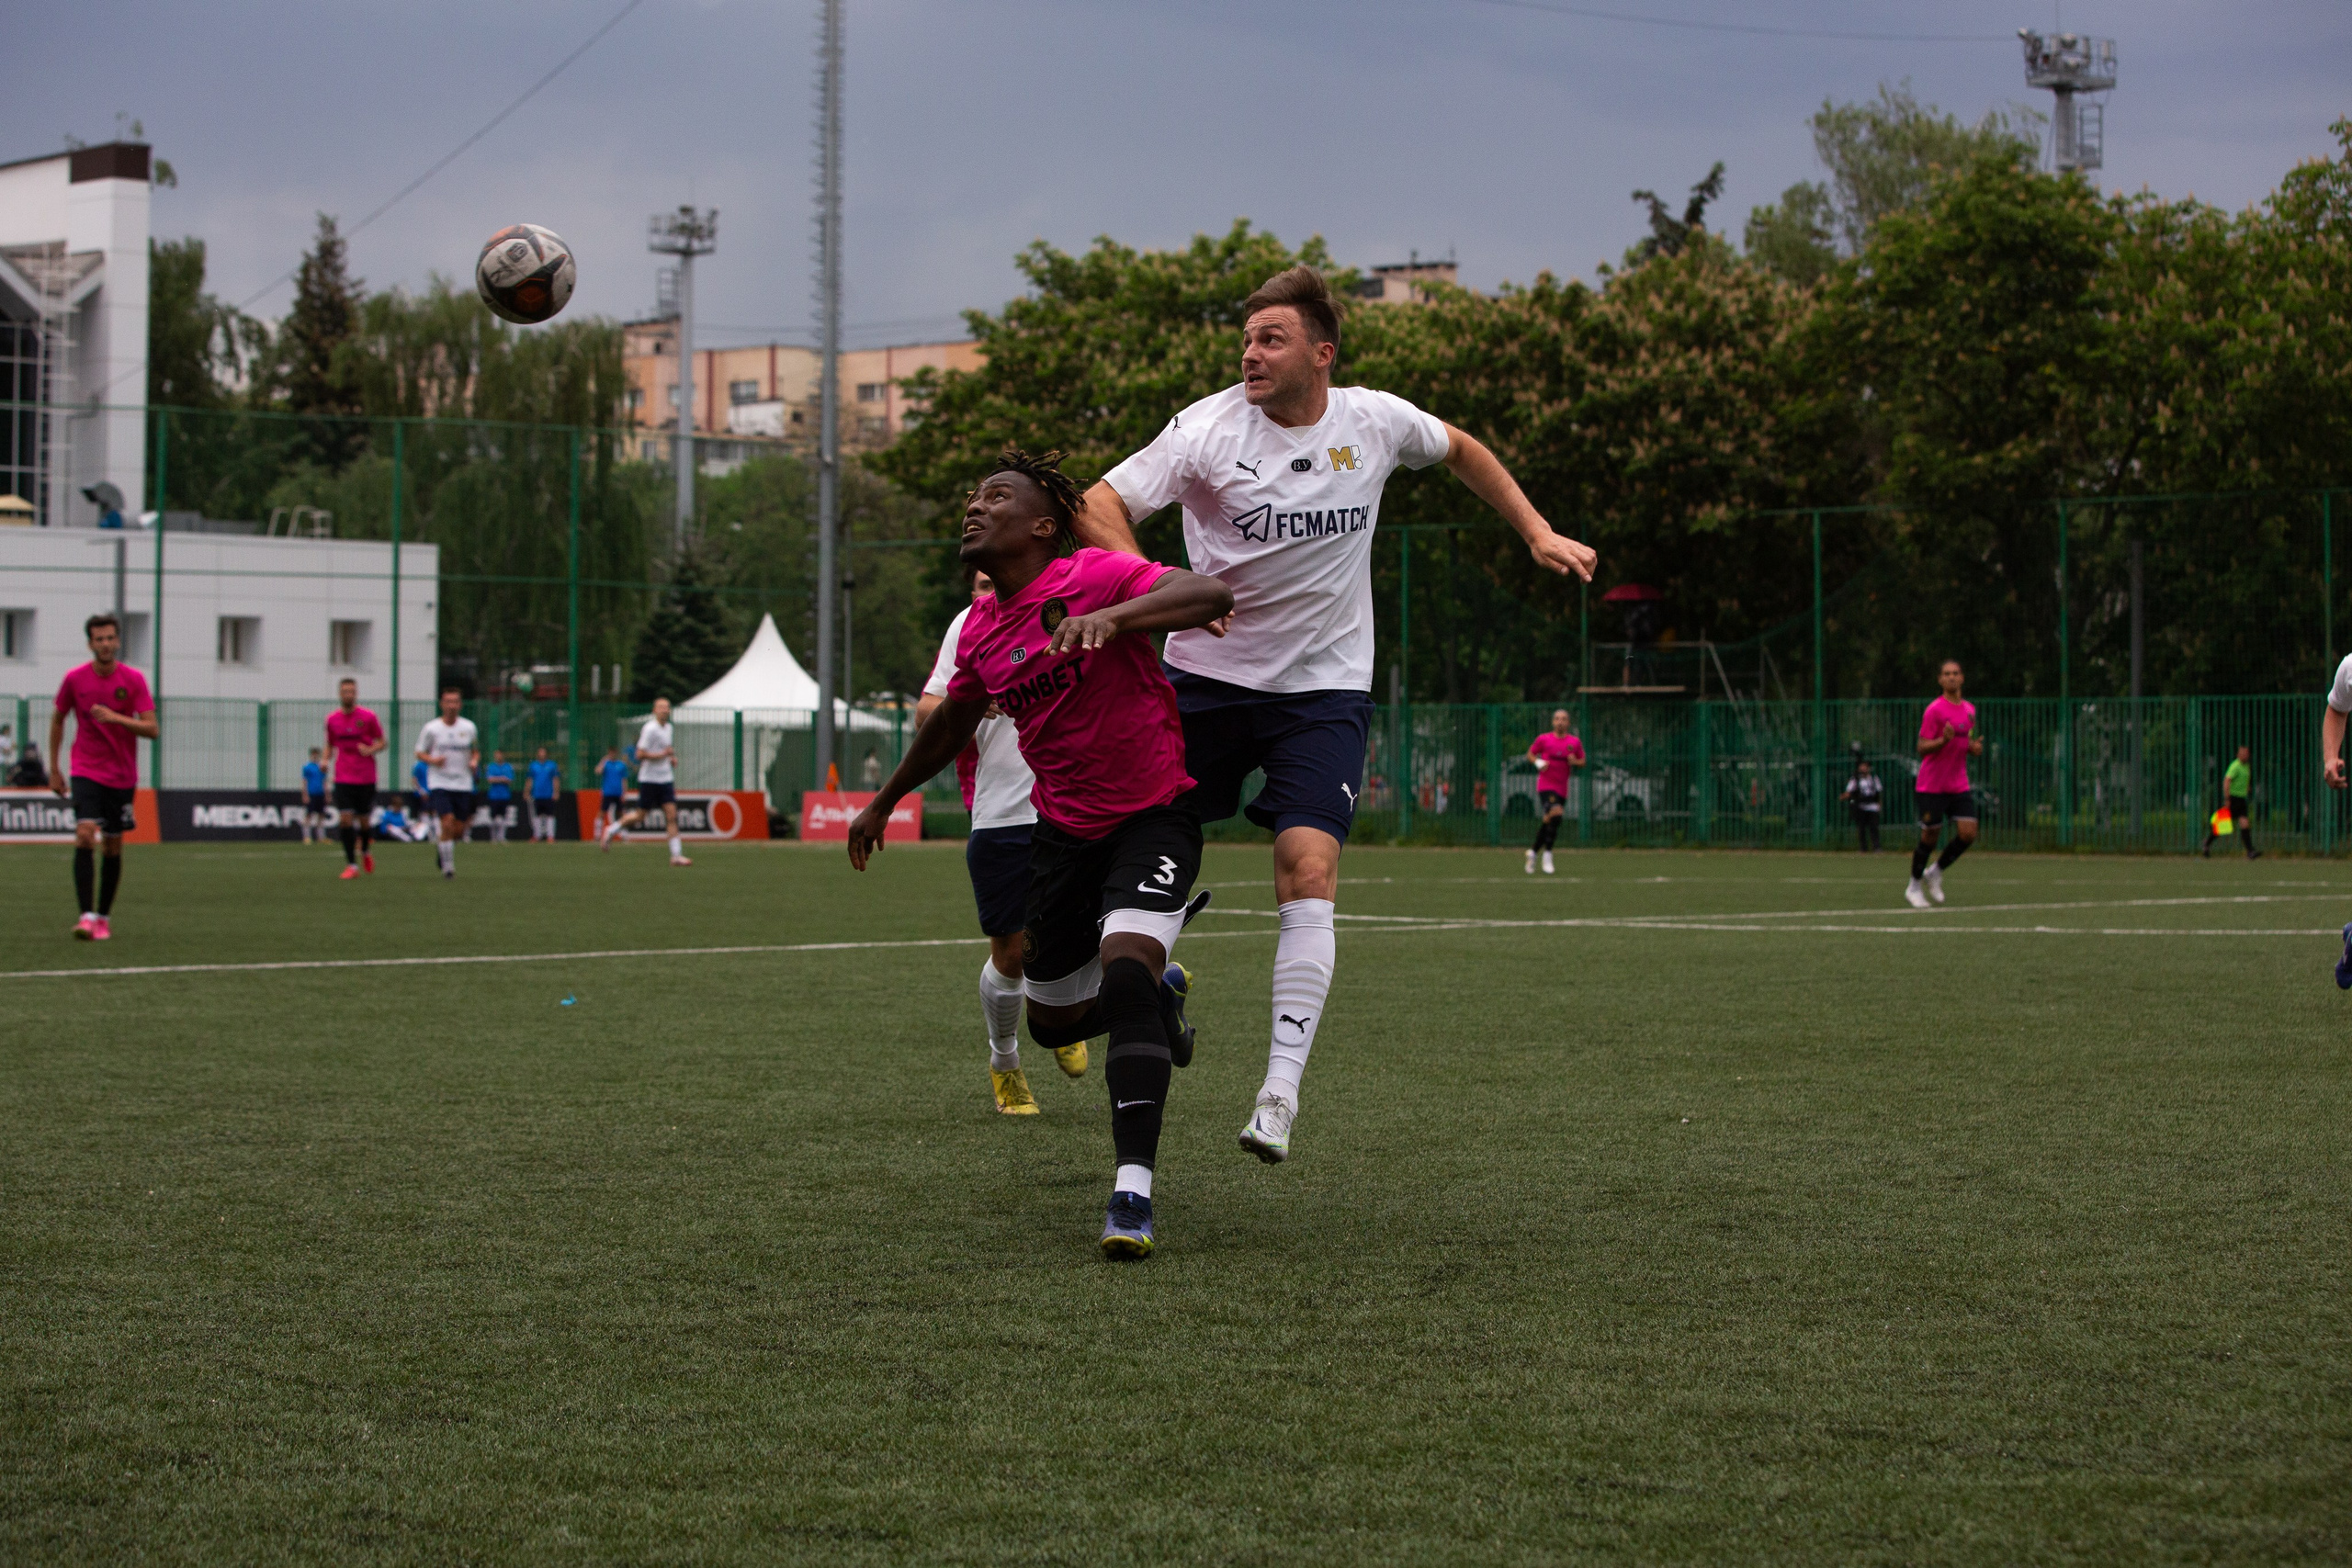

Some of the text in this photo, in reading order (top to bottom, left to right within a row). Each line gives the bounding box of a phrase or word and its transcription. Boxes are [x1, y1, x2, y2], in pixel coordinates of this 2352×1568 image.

[1276, 505, 1369, 538] FCMATCH
[997, 655, 1085, 712] FONBET
[0, 802, 77, 830] inline
[1152, 855, 1178, 885] 3
